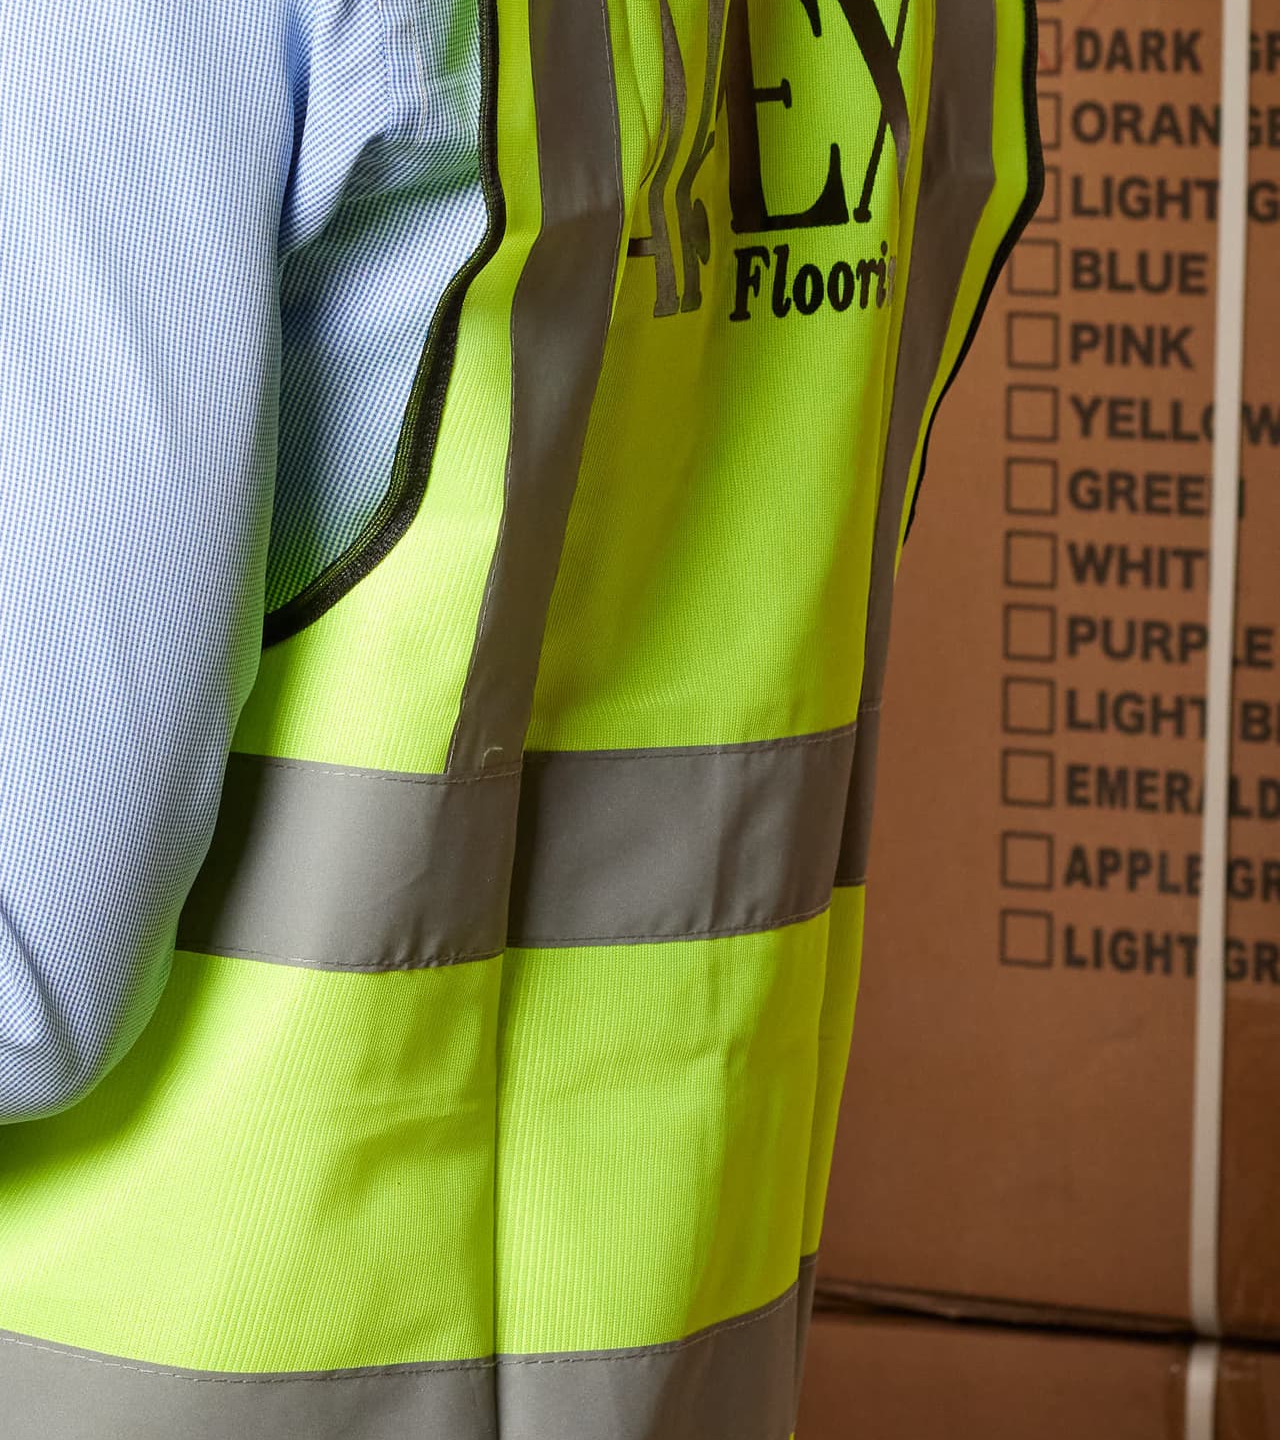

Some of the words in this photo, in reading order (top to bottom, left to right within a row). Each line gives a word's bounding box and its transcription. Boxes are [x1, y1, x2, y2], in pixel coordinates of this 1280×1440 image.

[1074, 29, 1203, 73] DARK
[1071, 175, 1221, 221] LIGHT
[1070, 248, 1208, 295] BLUE
[1070, 322, 1194, 370] PINK
[1068, 468, 1246, 518] GREE
[1068, 542, 1206, 590] WHIT
[1067, 616, 1275, 669] PURPE
